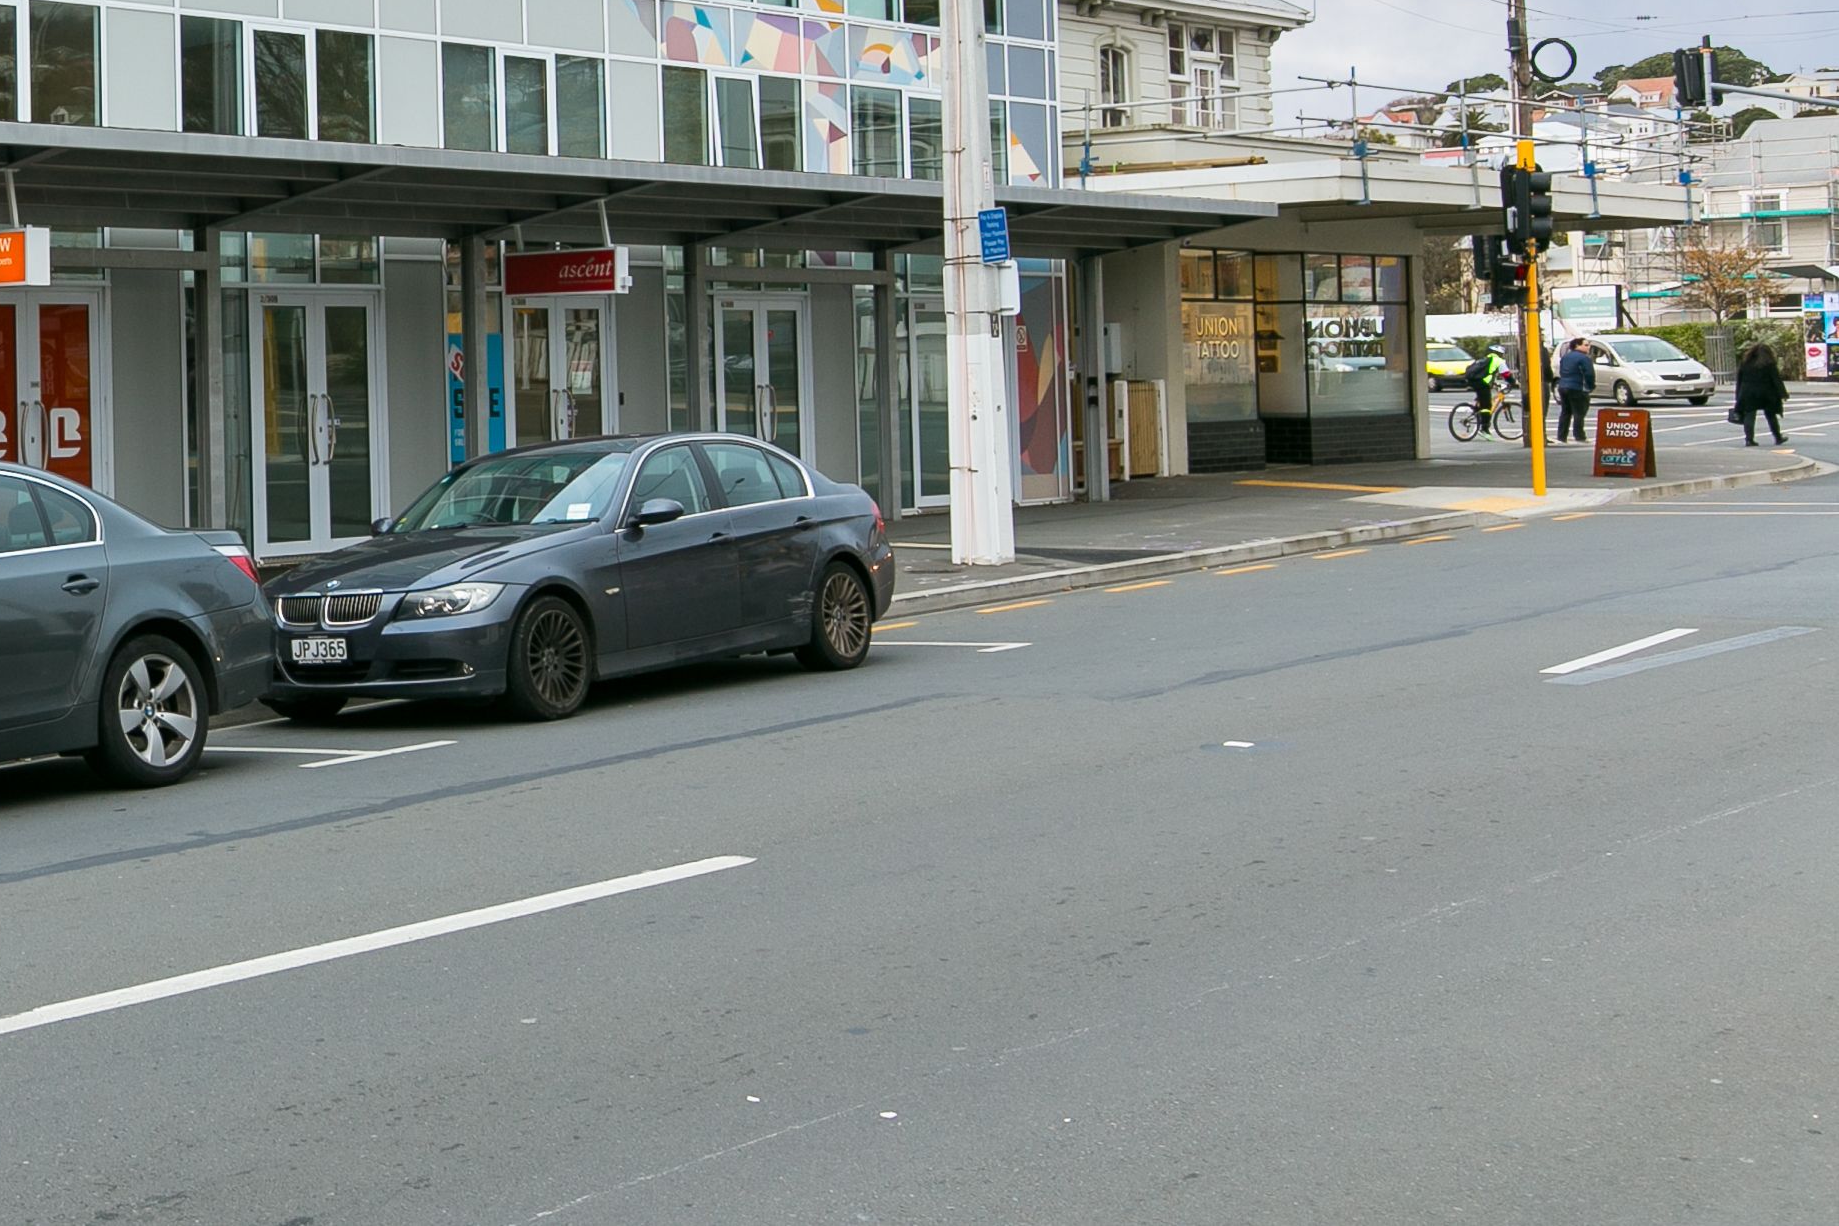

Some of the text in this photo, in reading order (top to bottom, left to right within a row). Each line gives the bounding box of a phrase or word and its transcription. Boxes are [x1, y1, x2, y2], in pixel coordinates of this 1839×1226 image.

[1195, 317, 1238, 336] UNION
[1195, 340, 1240, 358] TATTOO
[1606, 422, 1639, 430] UNION
[1606, 430, 1639, 438] TATTOO
[294, 640, 346, 658] JPJ365
